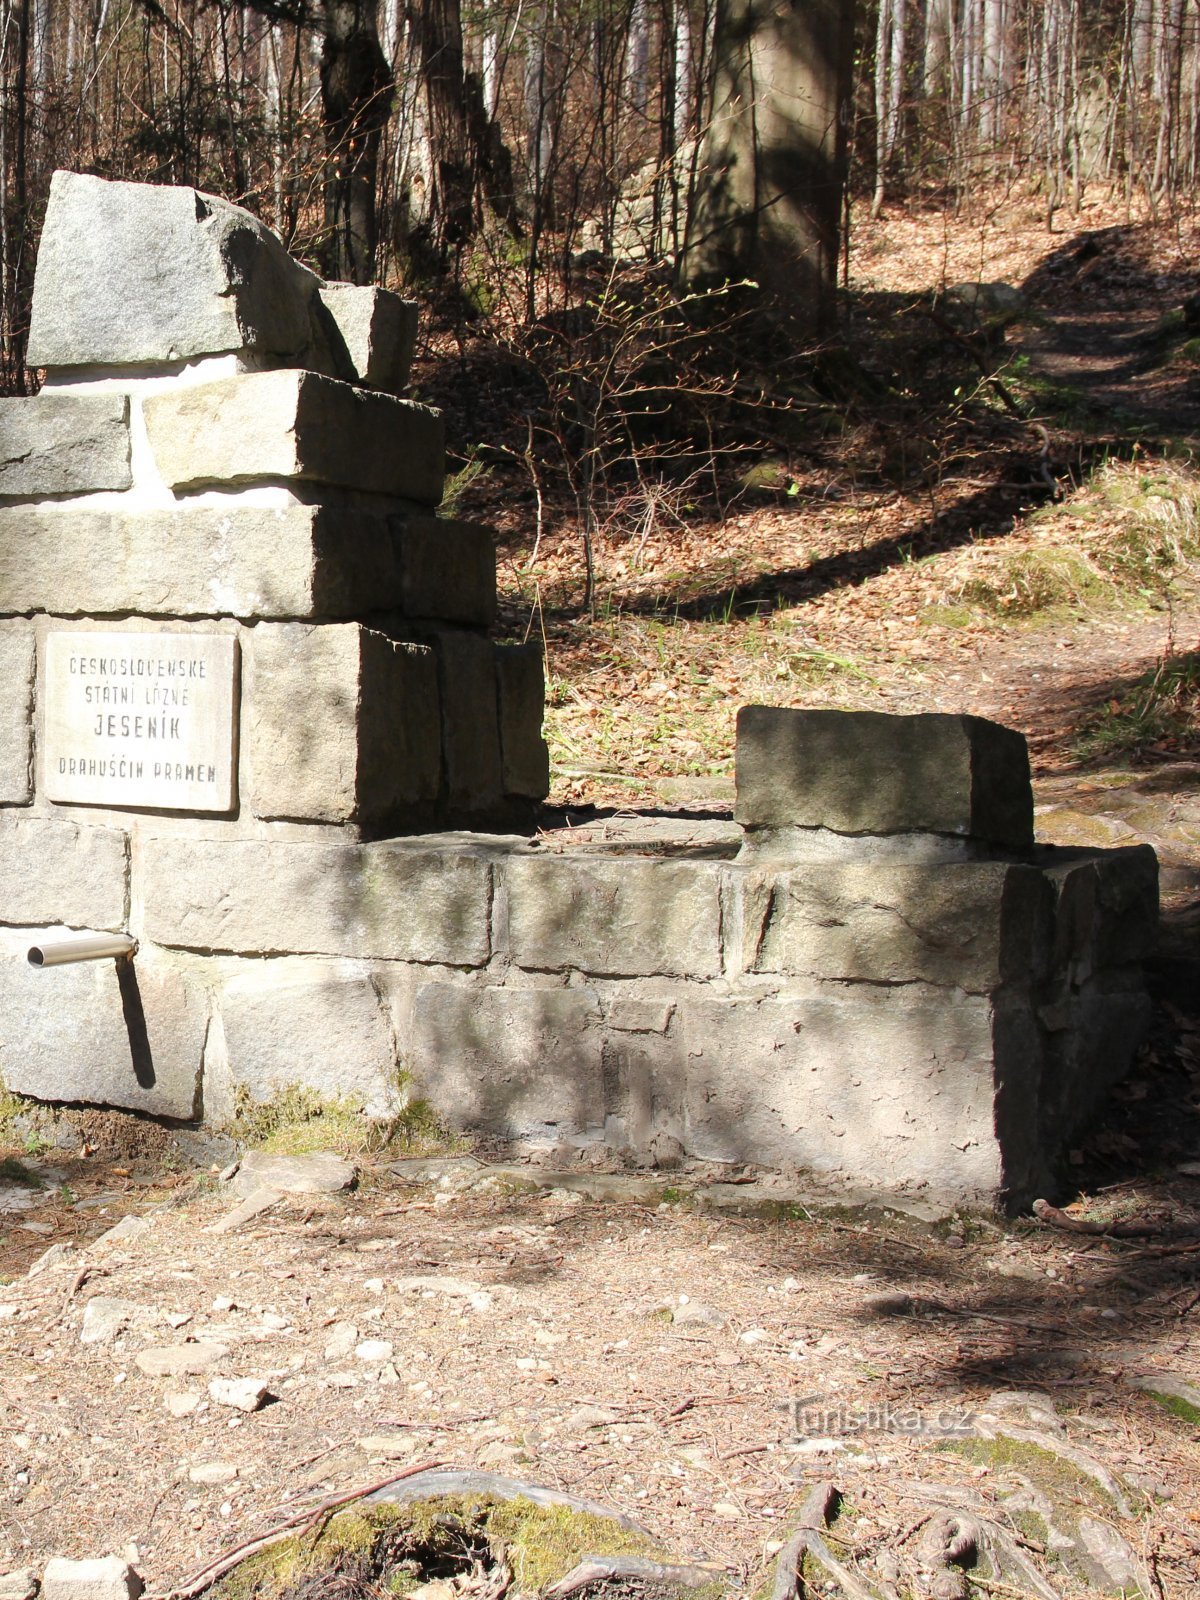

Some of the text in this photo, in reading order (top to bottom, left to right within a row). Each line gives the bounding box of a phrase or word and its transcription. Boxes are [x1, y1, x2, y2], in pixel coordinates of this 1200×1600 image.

[85, 680, 135, 705] STÁTNÍ
[94, 709, 180, 739] JESENÍK
[59, 753, 216, 783] DRAHUŠČIN PRAMEN
